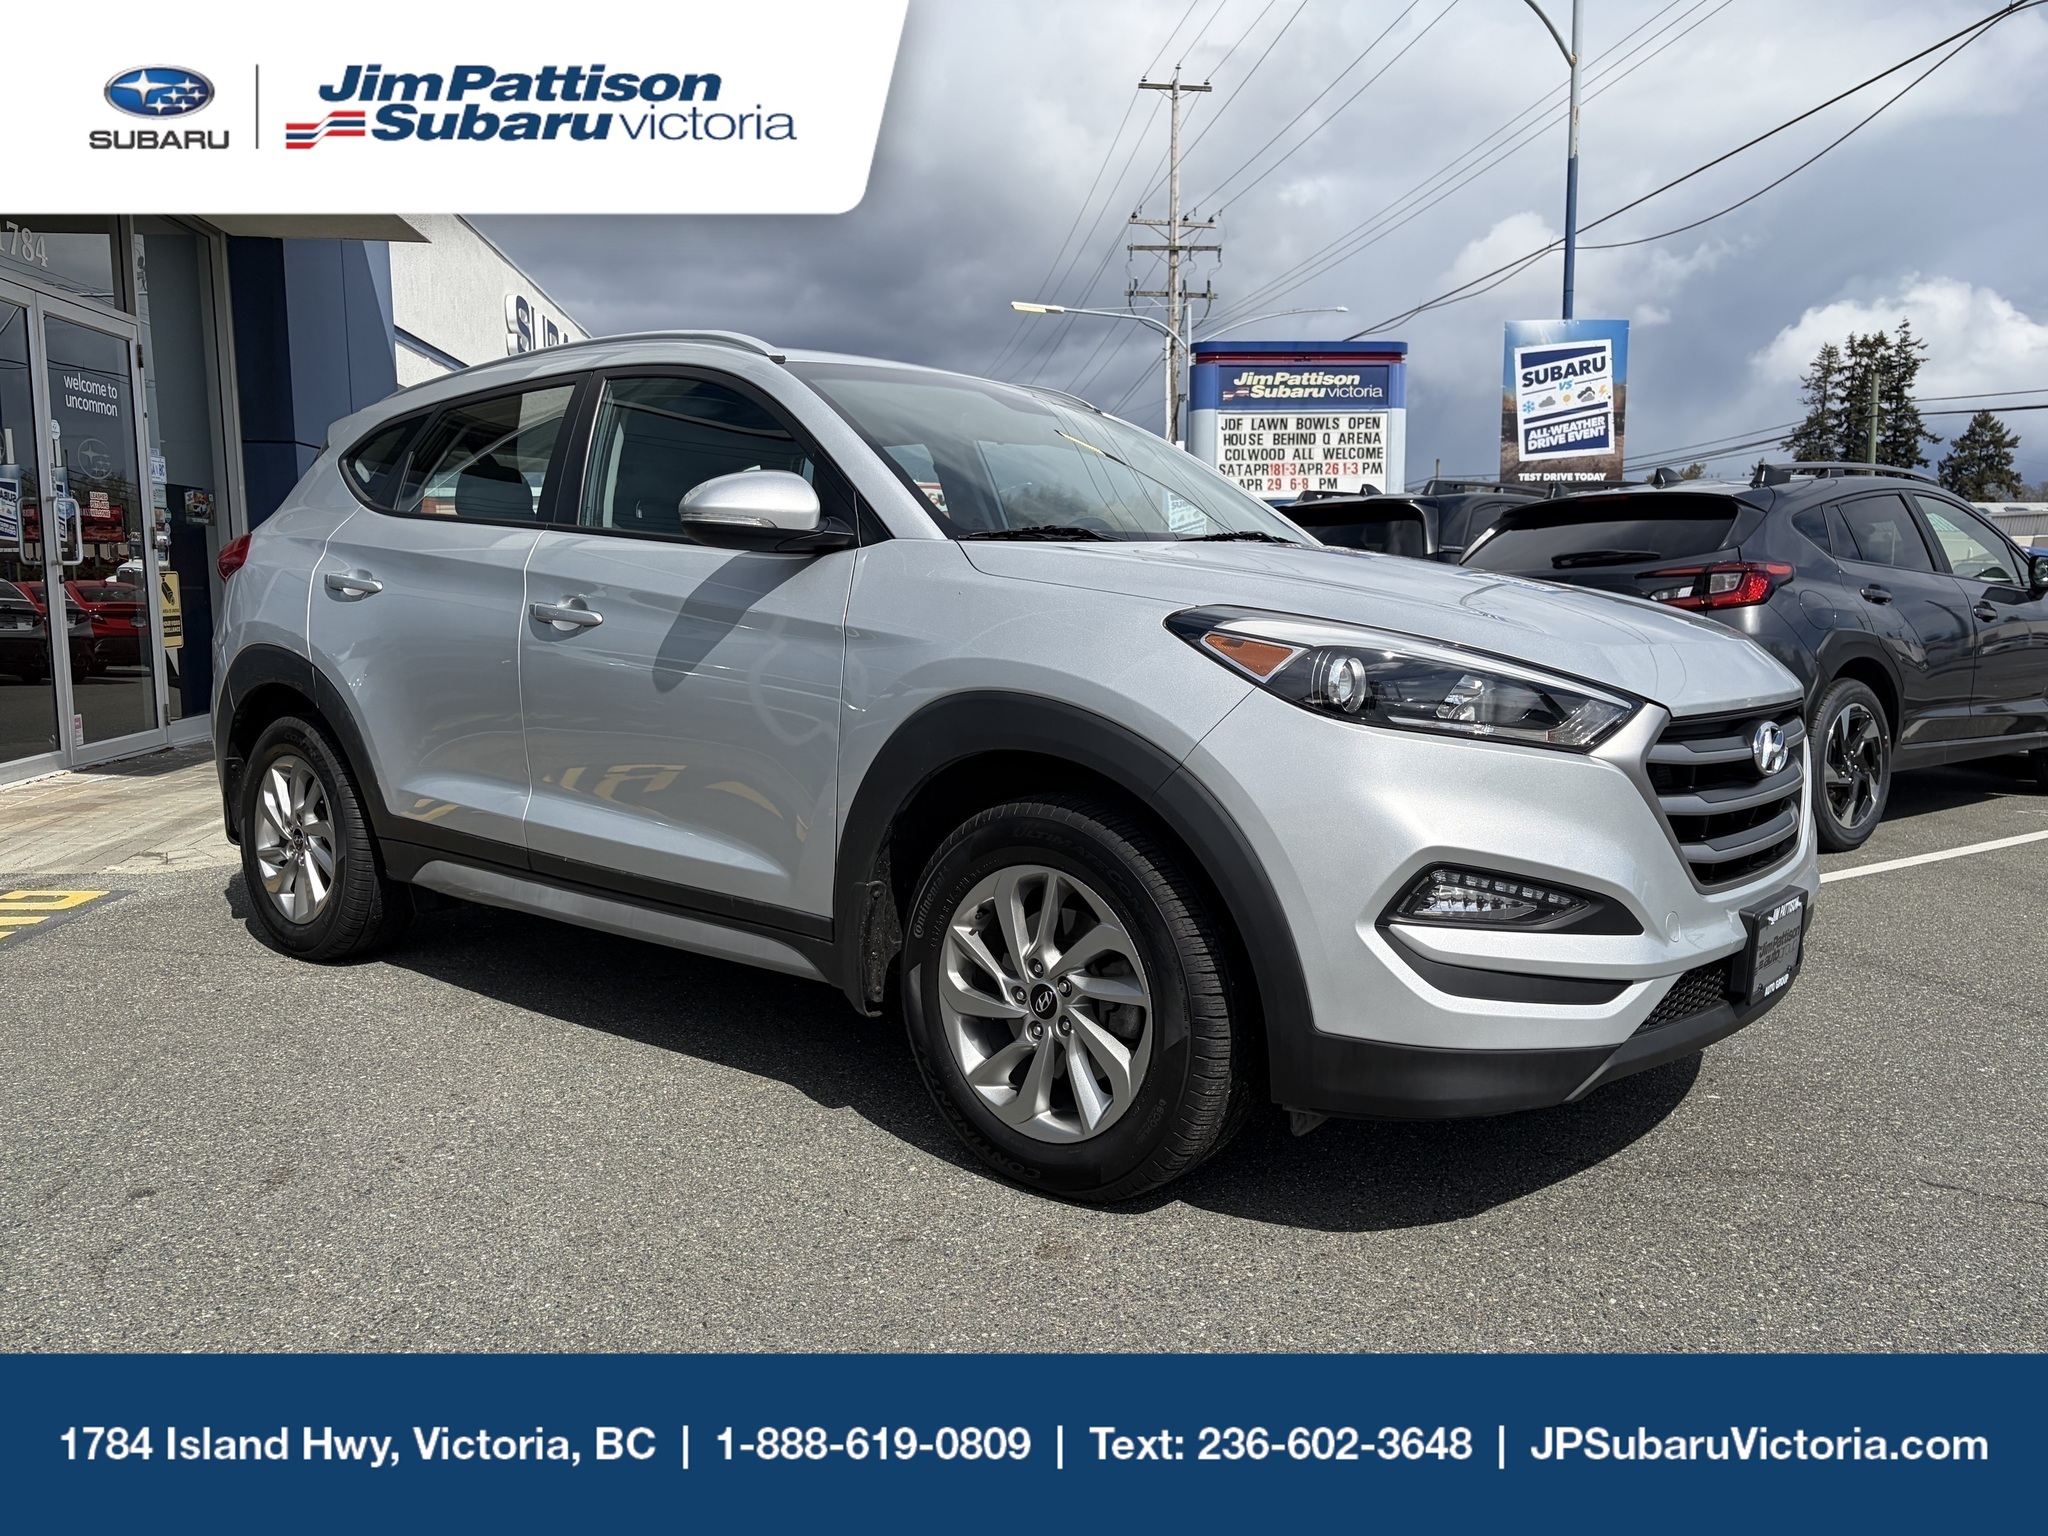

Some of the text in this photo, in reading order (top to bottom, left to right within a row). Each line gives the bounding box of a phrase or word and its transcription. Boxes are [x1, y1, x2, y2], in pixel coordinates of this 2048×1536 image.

[0, 220, 48, 268] 784
[1522, 356, 1606, 388] SUBARU
[63, 373, 118, 399] welcome to
[1250, 385, 1383, 398] Subaru victoria
[1558, 380, 1573, 391] VS
[65, 394, 118, 417] uncommon
[1221, 417, 1381, 431] JDF LAWN BOWLS OPEN
[1528, 416, 1606, 440] ALL-WEATHER
[1223, 432, 1382, 446] HOUSE BEHIND Q ARENA
[1528, 426, 1606, 451] DRIVE EVENT
[1224, 447, 1384, 461] COLWOOD ALL WELCOME
[1324, 463, 1339, 475] 26
[1362, 462, 1383, 475] PM
[1239, 478, 1338, 490] APR 29 6-8 PM
[1518, 473, 1607, 481] TEST DRIVE TODAY
